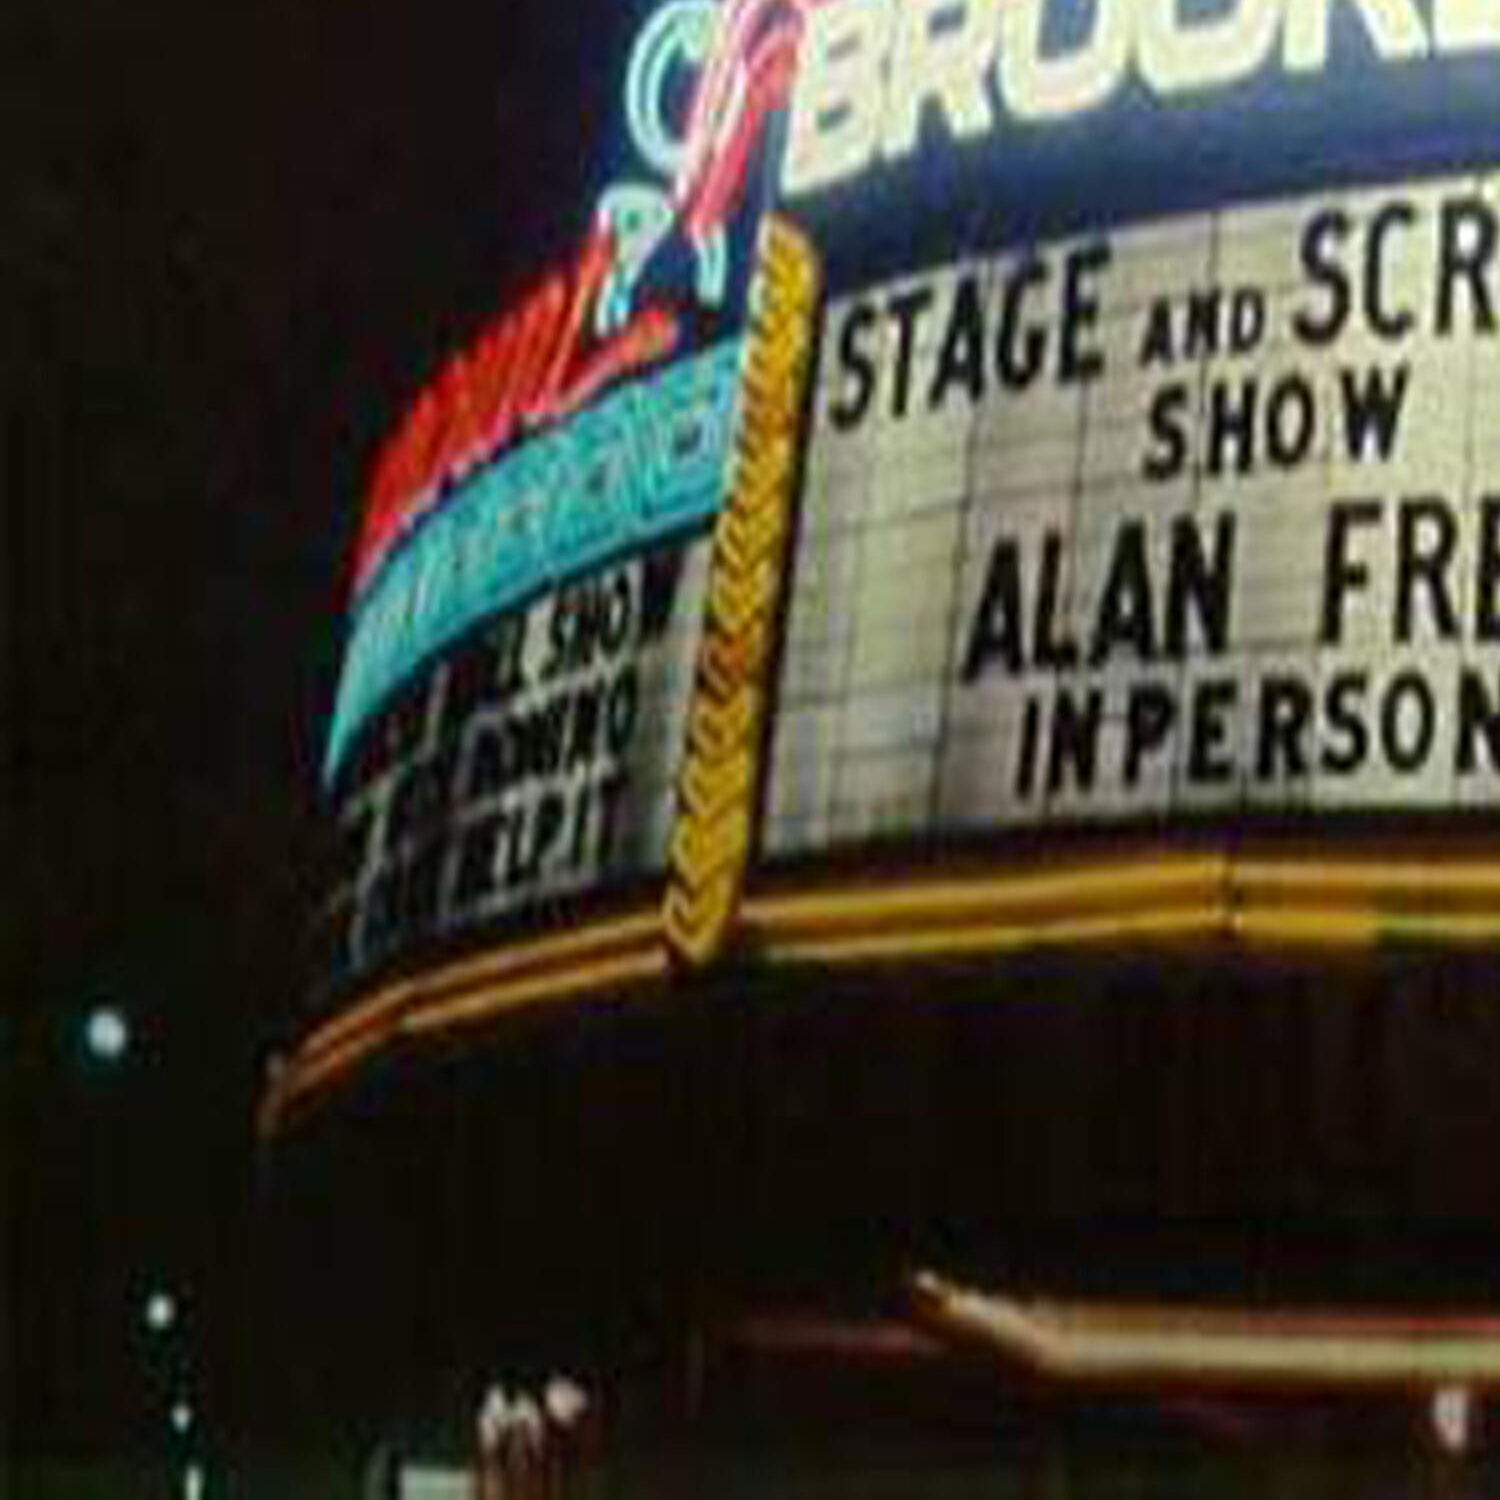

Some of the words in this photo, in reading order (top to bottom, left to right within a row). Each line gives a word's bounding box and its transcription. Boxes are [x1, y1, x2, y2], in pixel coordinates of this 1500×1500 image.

[829, 241, 1112, 434] STAGE
[1140, 285, 1266, 365] AND
[1143, 366, 1410, 481] SHOW
[960, 510, 1238, 684] ALAN
